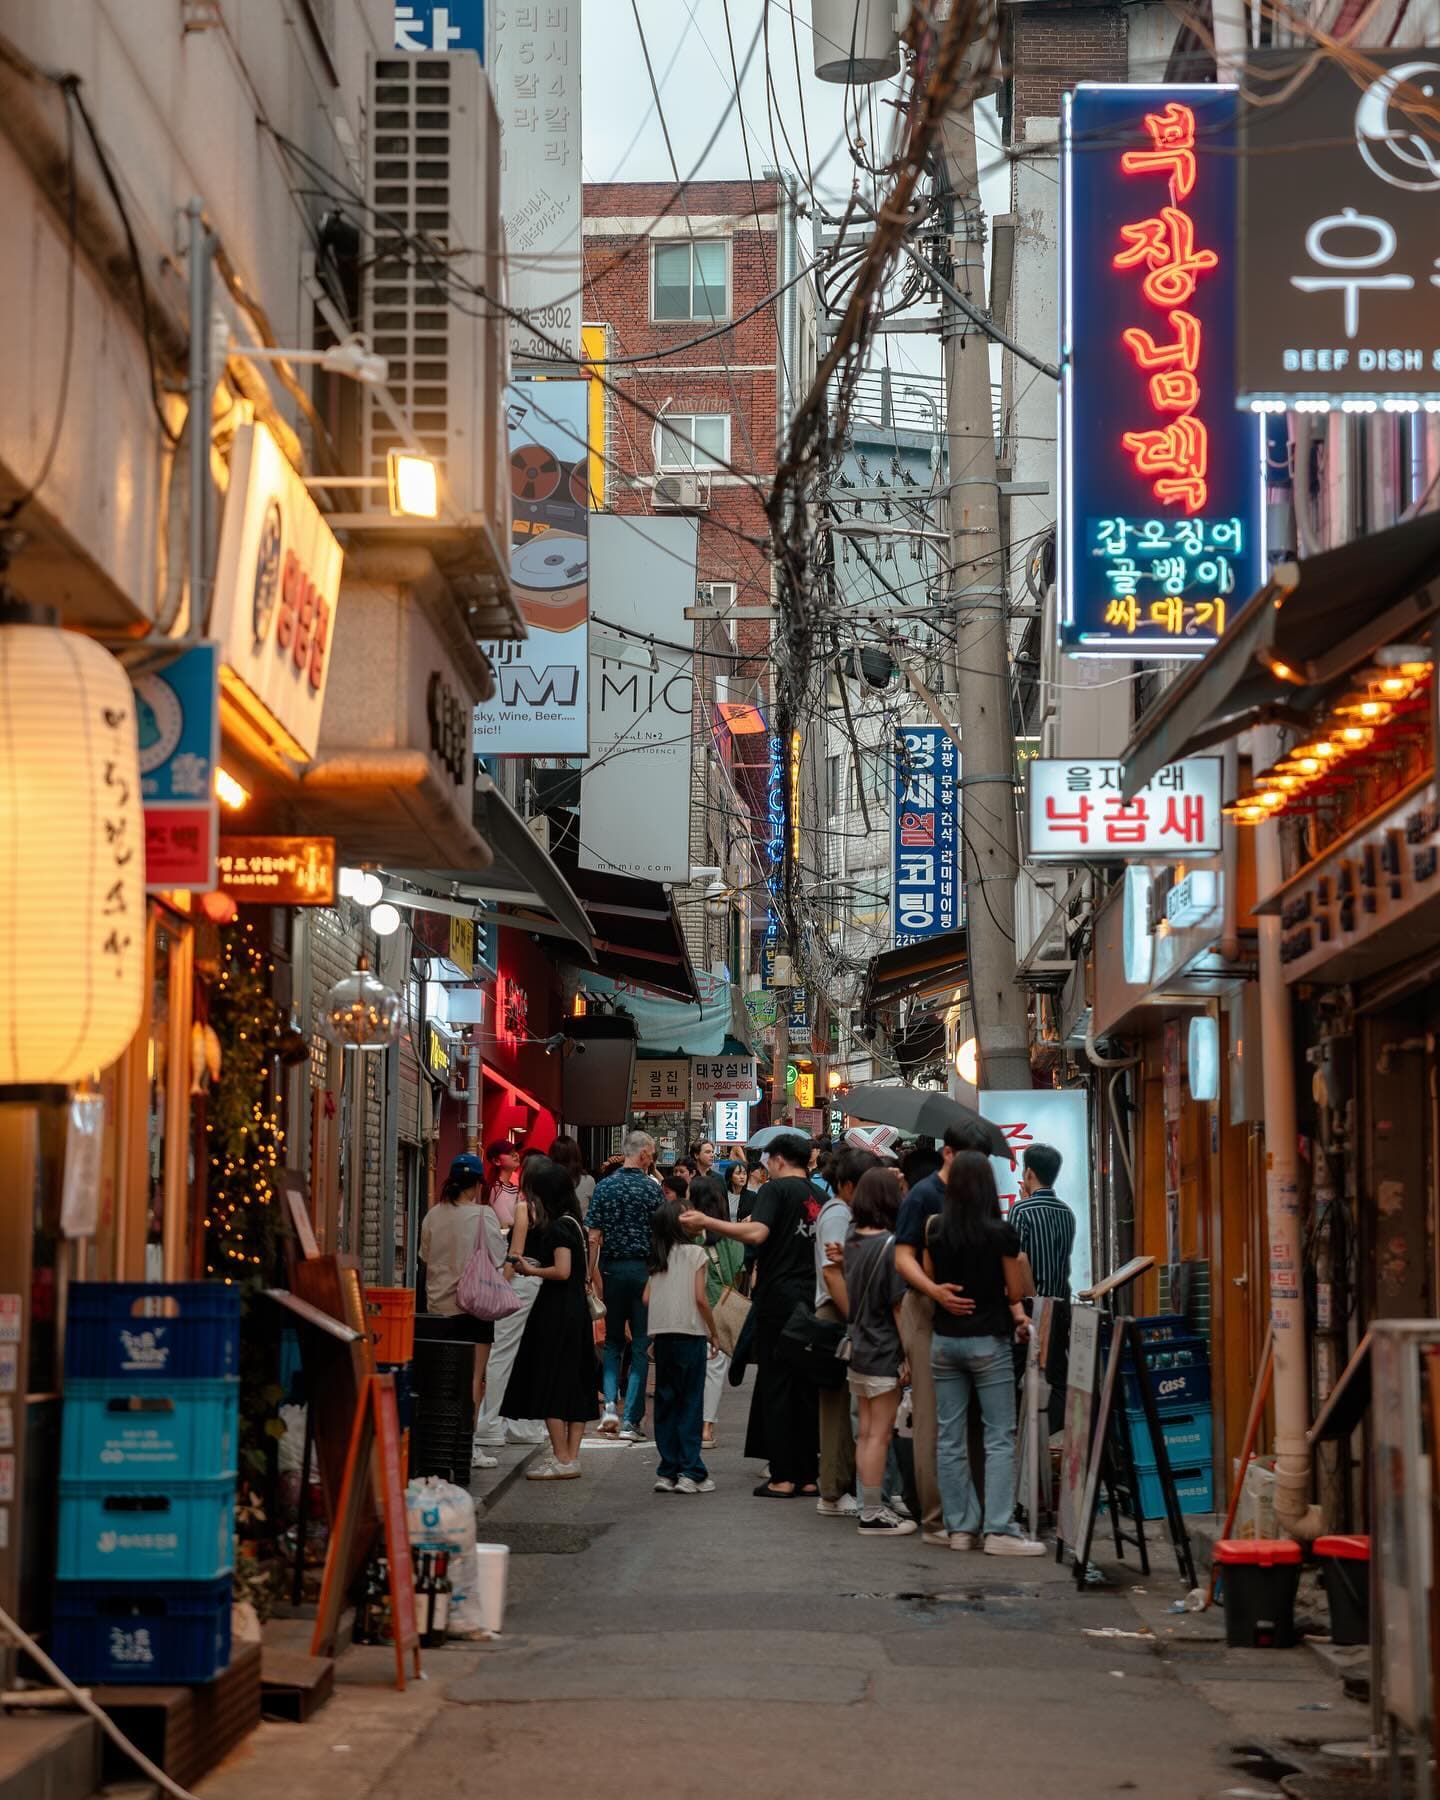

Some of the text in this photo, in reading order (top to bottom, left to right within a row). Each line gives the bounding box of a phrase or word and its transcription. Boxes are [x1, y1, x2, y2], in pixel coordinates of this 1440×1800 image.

[1289, 206, 1440, 339] 우
[1283, 348, 1350, 372] BEEF
[1358, 348, 1424, 372] DISH
[1096, 516, 1242, 555] 갑오징어
[1105, 556, 1229, 595] 골뱅이
[1104, 595, 1226, 636] 싸대기
[473, 711, 496, 723] sky,
[499, 711, 532, 722] Wine,
[1066, 765, 1185, 792] 을지래
[1045, 793, 1205, 844] 낙곱새
[696, 1062, 753, 1079] 태광설비
[1158, 1376, 1186, 1395] Cass
